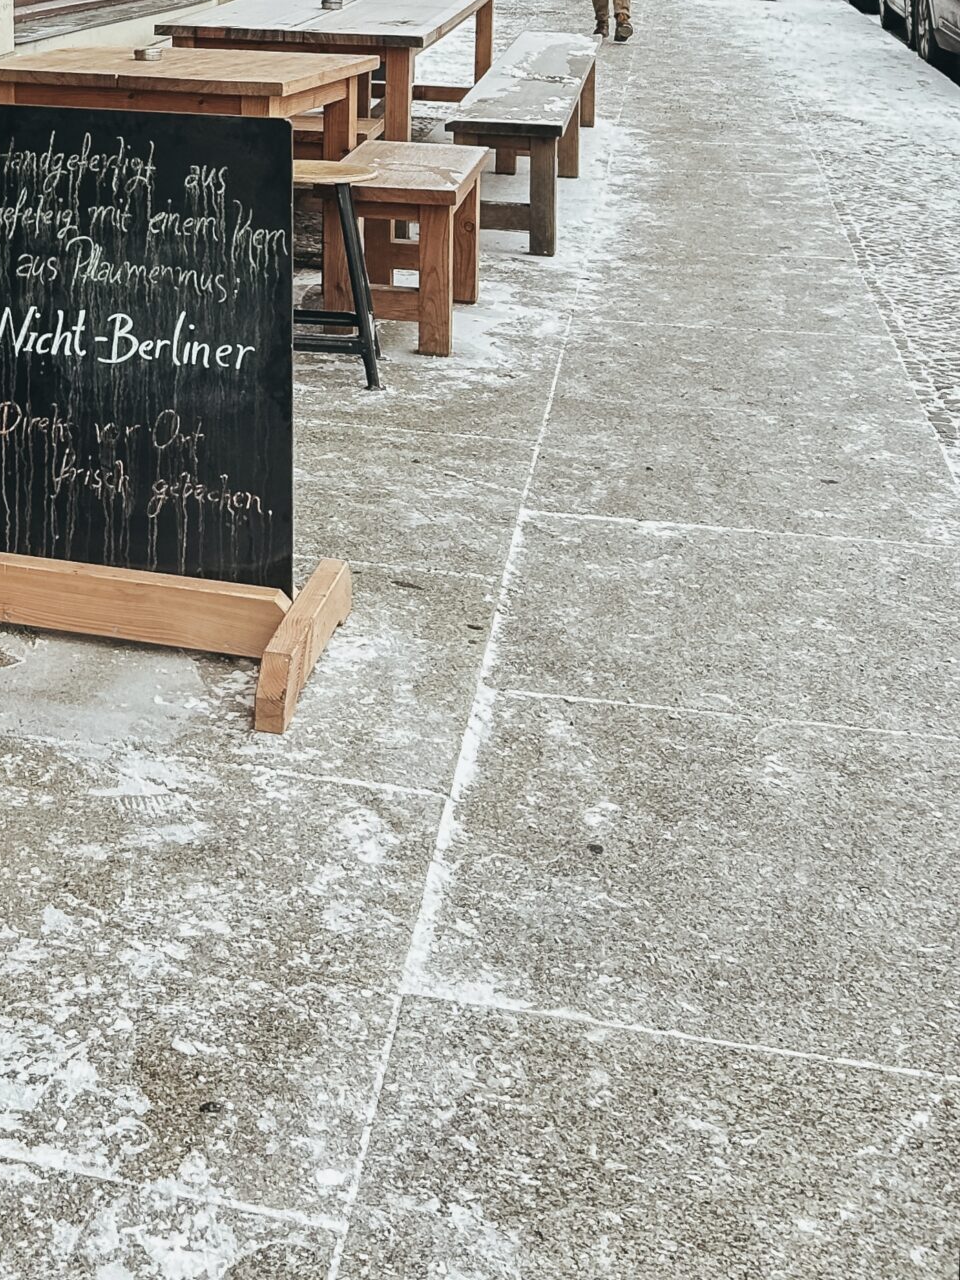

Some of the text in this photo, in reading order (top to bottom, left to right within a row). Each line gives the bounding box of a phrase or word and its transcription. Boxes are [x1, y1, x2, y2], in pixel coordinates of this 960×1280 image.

[184, 165, 228, 194] aus
[88, 198, 133, 232] mit
[150, 199, 218, 241] einem
[16, 254, 58, 283] aus
